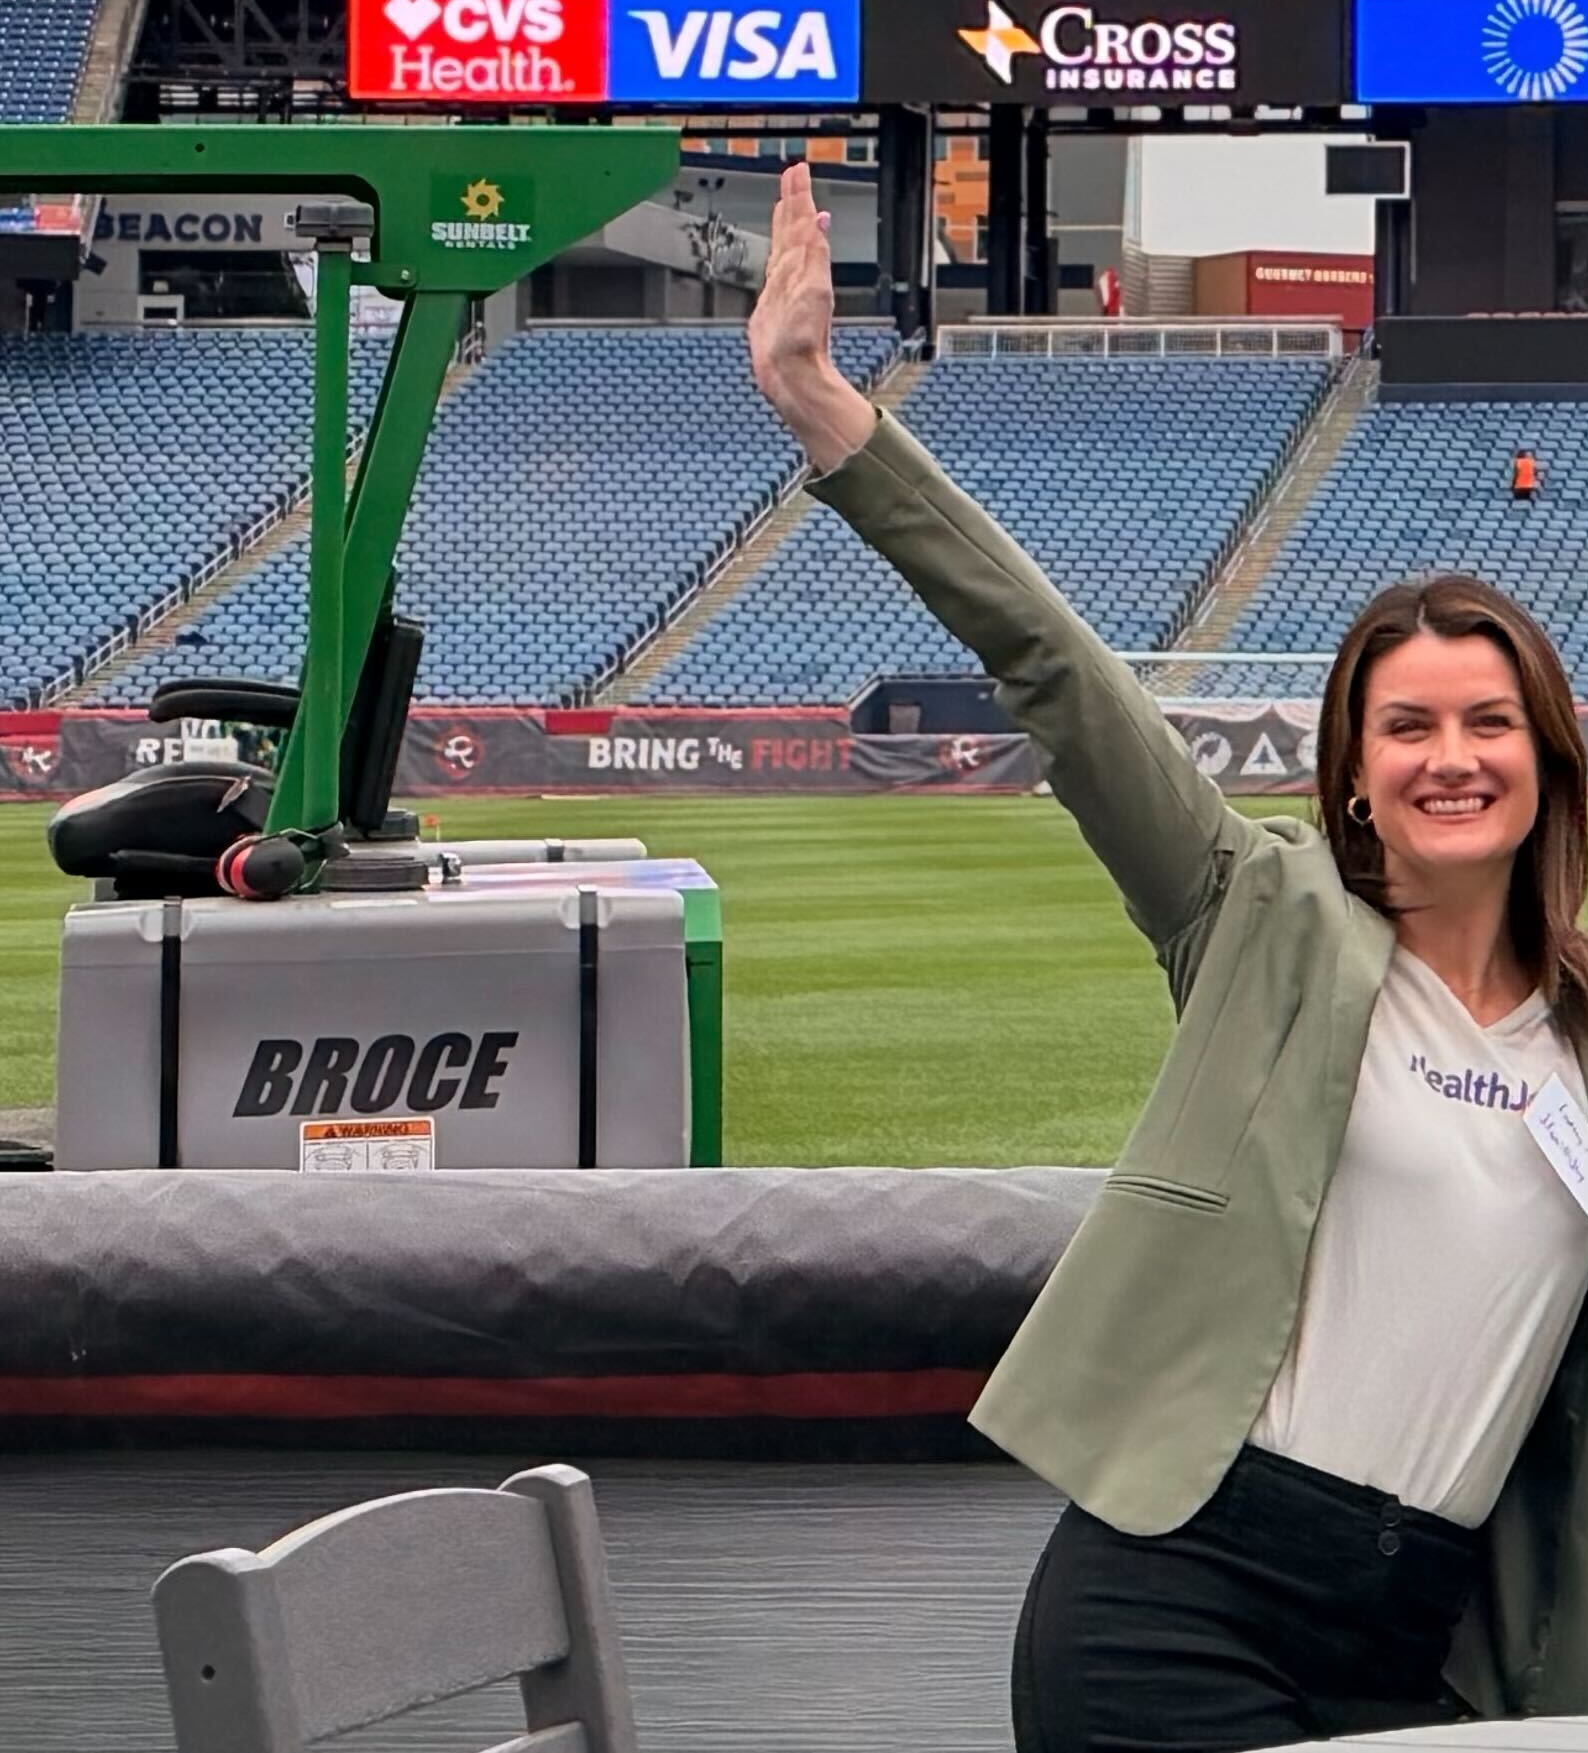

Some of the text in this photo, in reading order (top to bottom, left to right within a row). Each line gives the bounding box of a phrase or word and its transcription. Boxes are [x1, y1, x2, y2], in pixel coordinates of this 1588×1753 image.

[627, 11, 838, 80] VISA
[1045, 68, 1236, 89] INSURANCE
[93, 213, 262, 243] BEACON
[431, 222, 531, 241] SUNBELT
[589, 737, 853, 771] BRING THE FIGHT
[232, 1032, 519, 1118] BROCE
